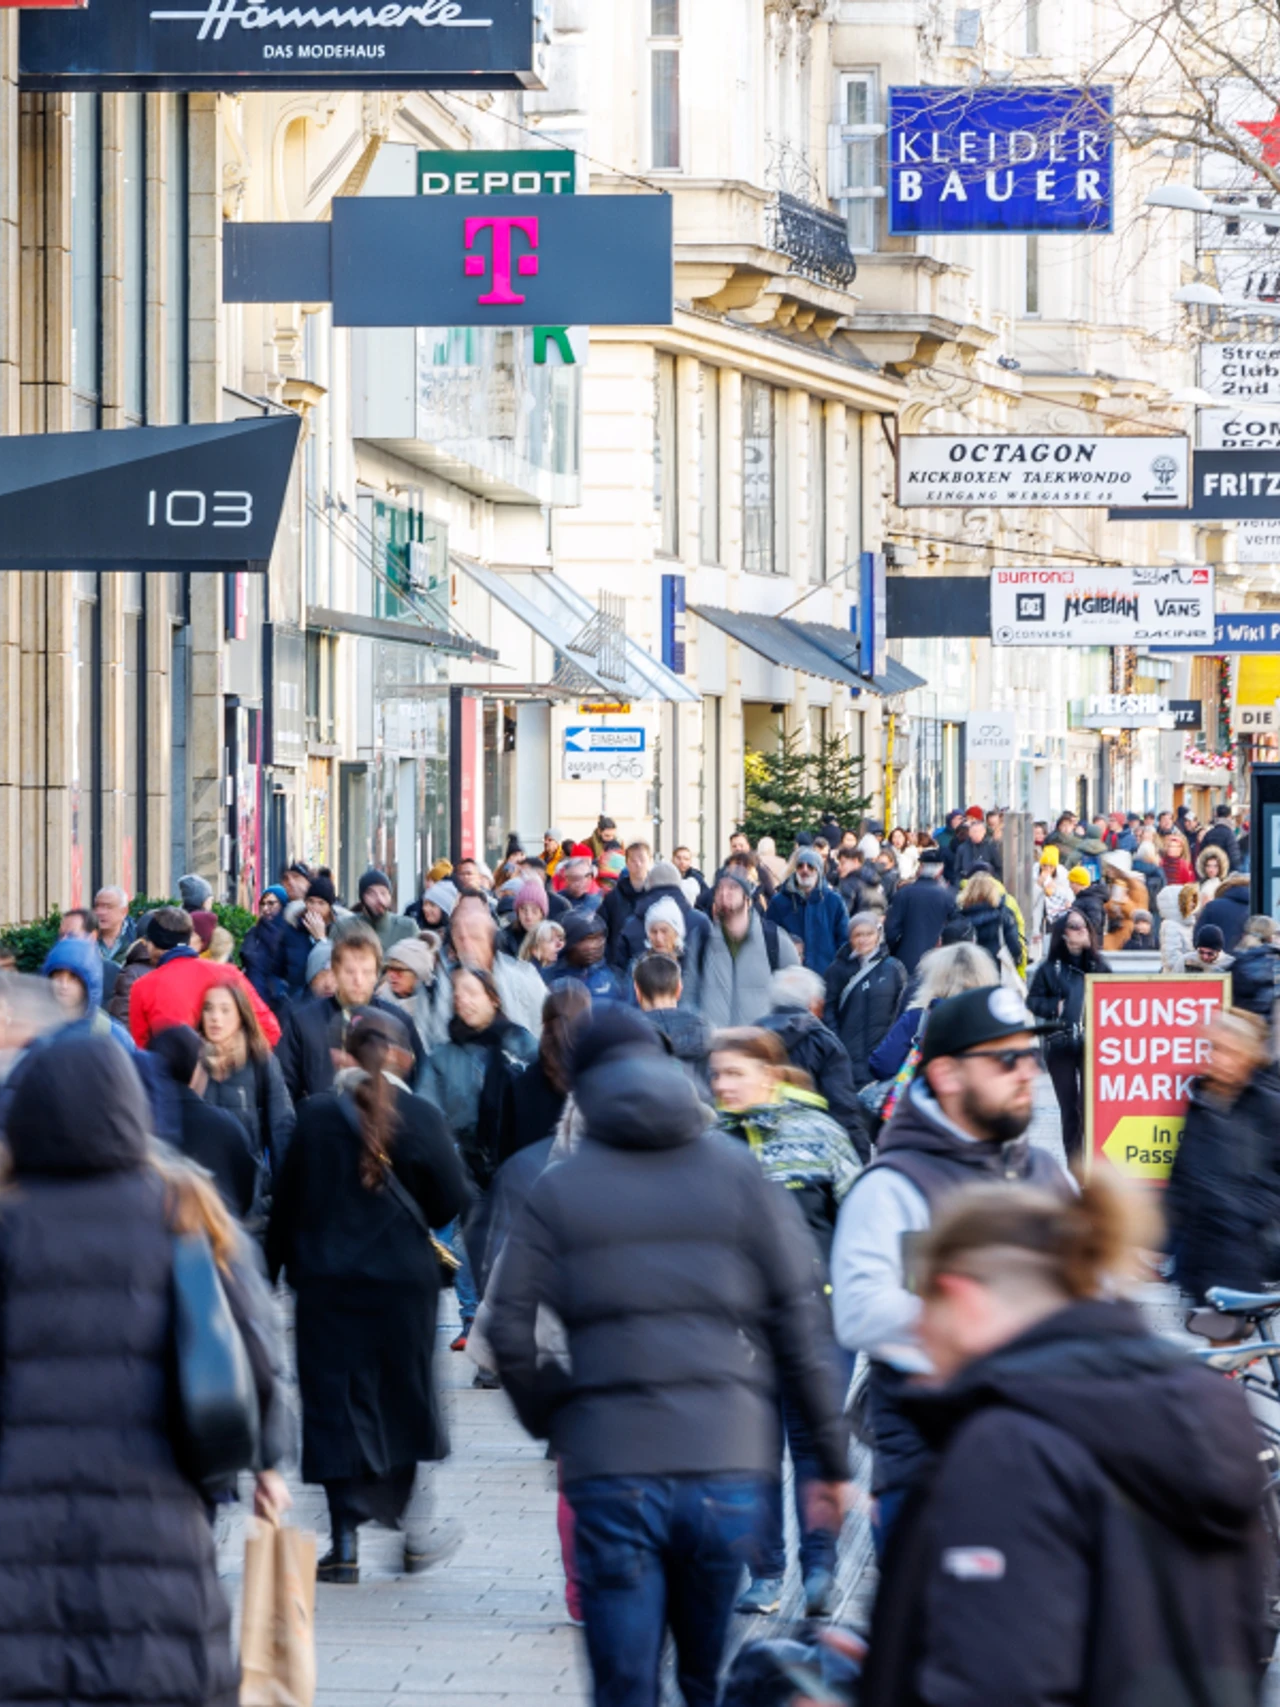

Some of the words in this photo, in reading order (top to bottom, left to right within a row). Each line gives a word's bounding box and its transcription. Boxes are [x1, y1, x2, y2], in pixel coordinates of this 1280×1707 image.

[263, 44, 294, 59] DAS
[298, 44, 386, 59] MODEHAUS
[898, 131, 1102, 164] KLEIDER
[422, 171, 572, 195] DEPOT
[898, 169, 1102, 202] BAUER
[1222, 364, 1279, 377] Club
[1222, 381, 1269, 395] 2nd
[948, 443, 1097, 463] OCTAGON
[907, 471, 1011, 484] KICKBOXEN
[1022, 471, 1132, 484] TAEKWONDO
[926, 490, 999, 501] EINGANG
[147, 490, 253, 528] 103
[1242, 711, 1273, 725] DIE
[591, 733, 637, 746] EINBAHN
[1099, 998, 1219, 1027] KUNST
[1098, 1037, 1214, 1066] SUPER
[1100, 1074, 1196, 1102] MARK
[1153, 1124, 1171, 1144] In
